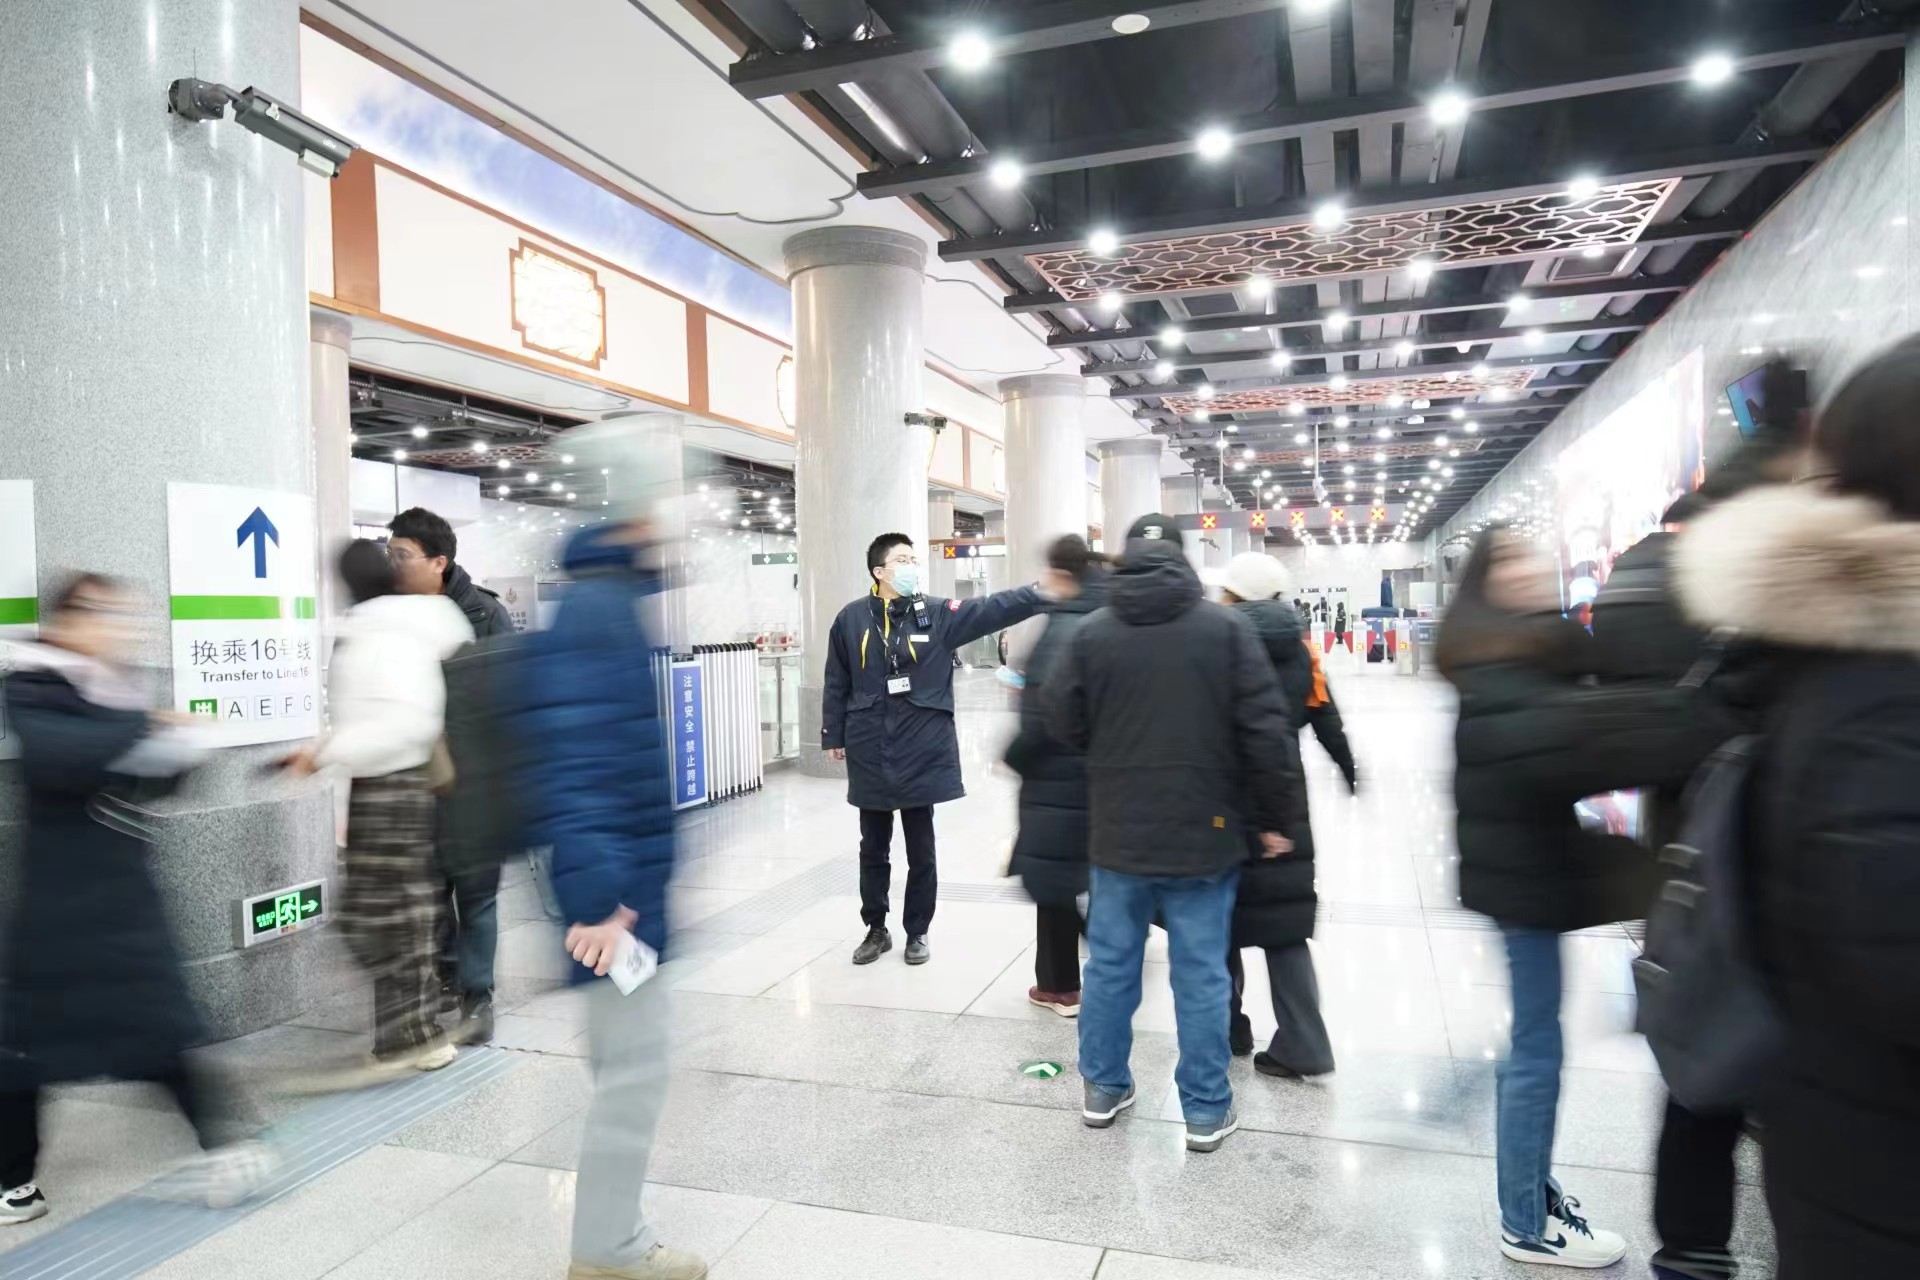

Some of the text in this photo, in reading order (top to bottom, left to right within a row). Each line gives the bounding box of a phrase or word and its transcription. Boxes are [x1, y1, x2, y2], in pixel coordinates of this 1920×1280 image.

[191, 638, 311, 665] 换乘16号线
[200, 669, 258, 683] Transfer
[262, 669, 273, 680] to
[277, 668, 297, 679] Line
[228, 695, 312, 719] A E F G
[683, 675, 697, 796] 注意安全 禁止跨越
